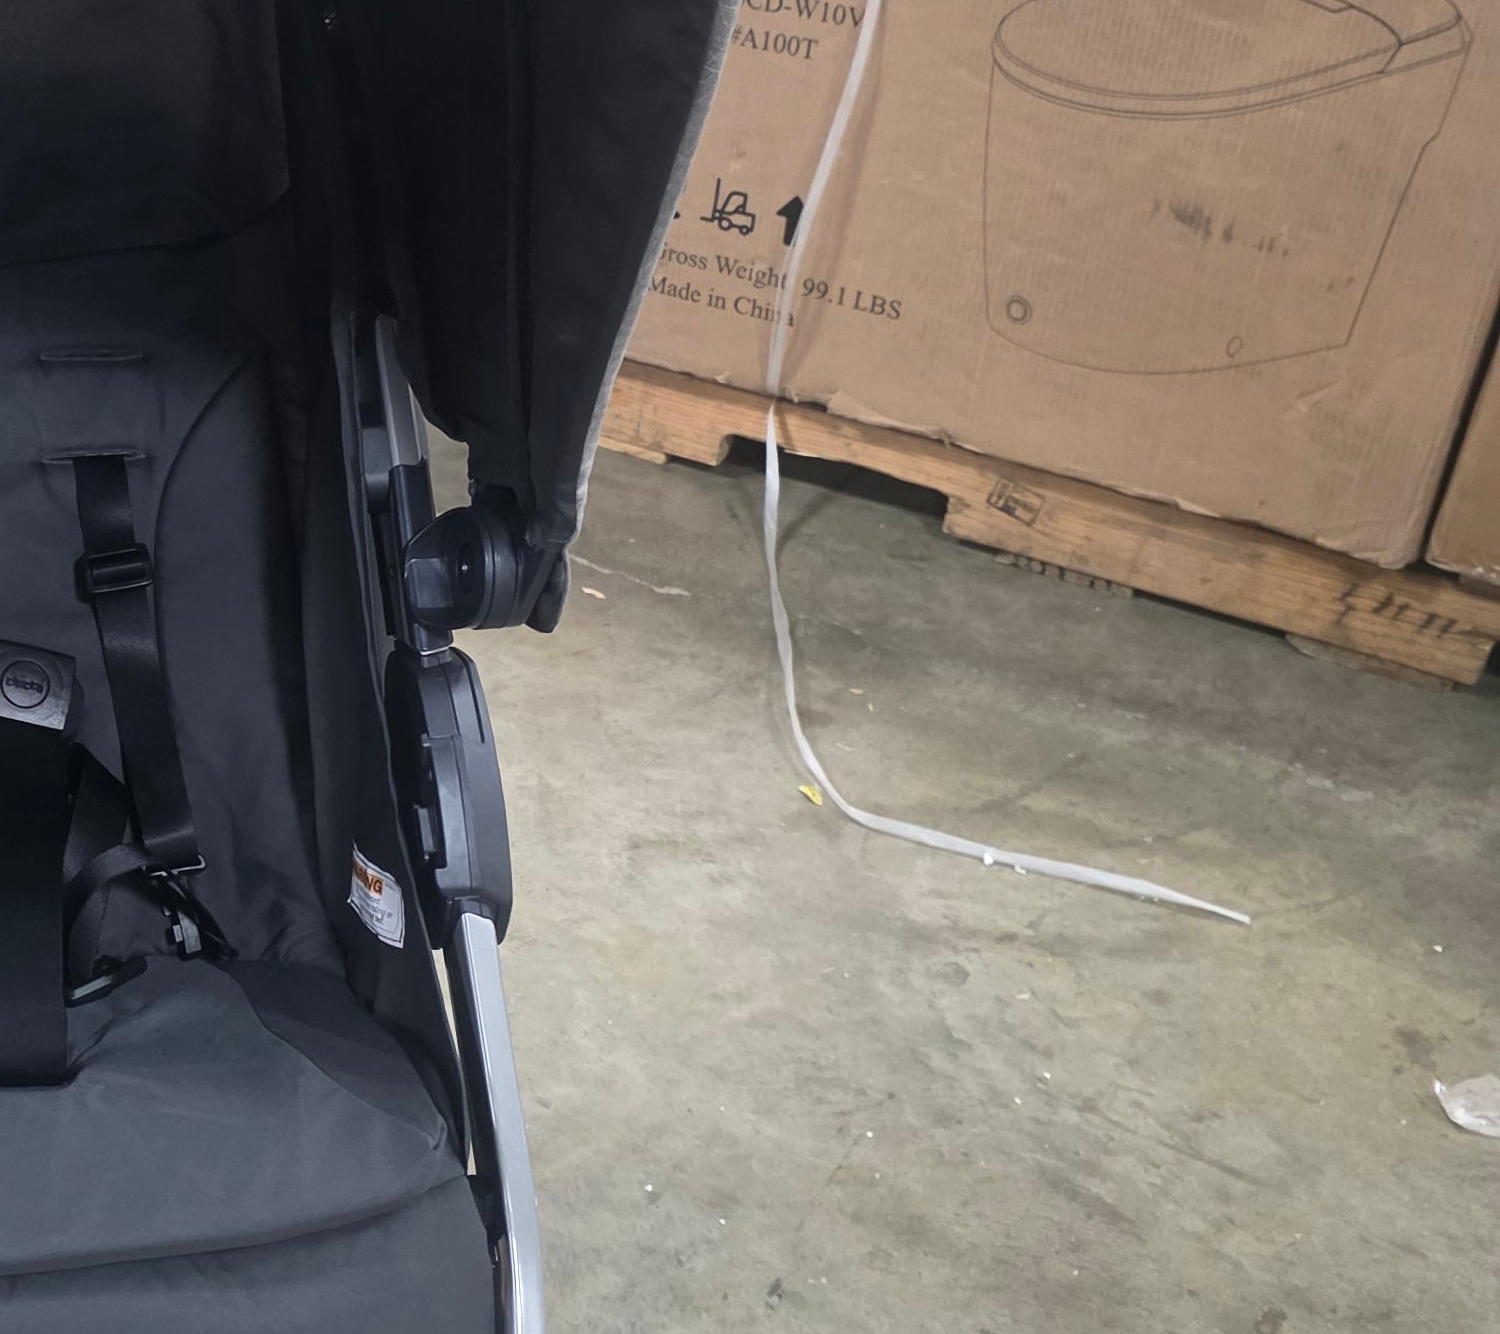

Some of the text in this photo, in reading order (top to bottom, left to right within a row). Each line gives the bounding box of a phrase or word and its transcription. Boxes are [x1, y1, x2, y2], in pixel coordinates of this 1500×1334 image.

[648, 275, 702, 304] Made
[706, 288, 727, 311] in
[801, 277, 846, 307] 99.1
[852, 289, 902, 322] LBS
